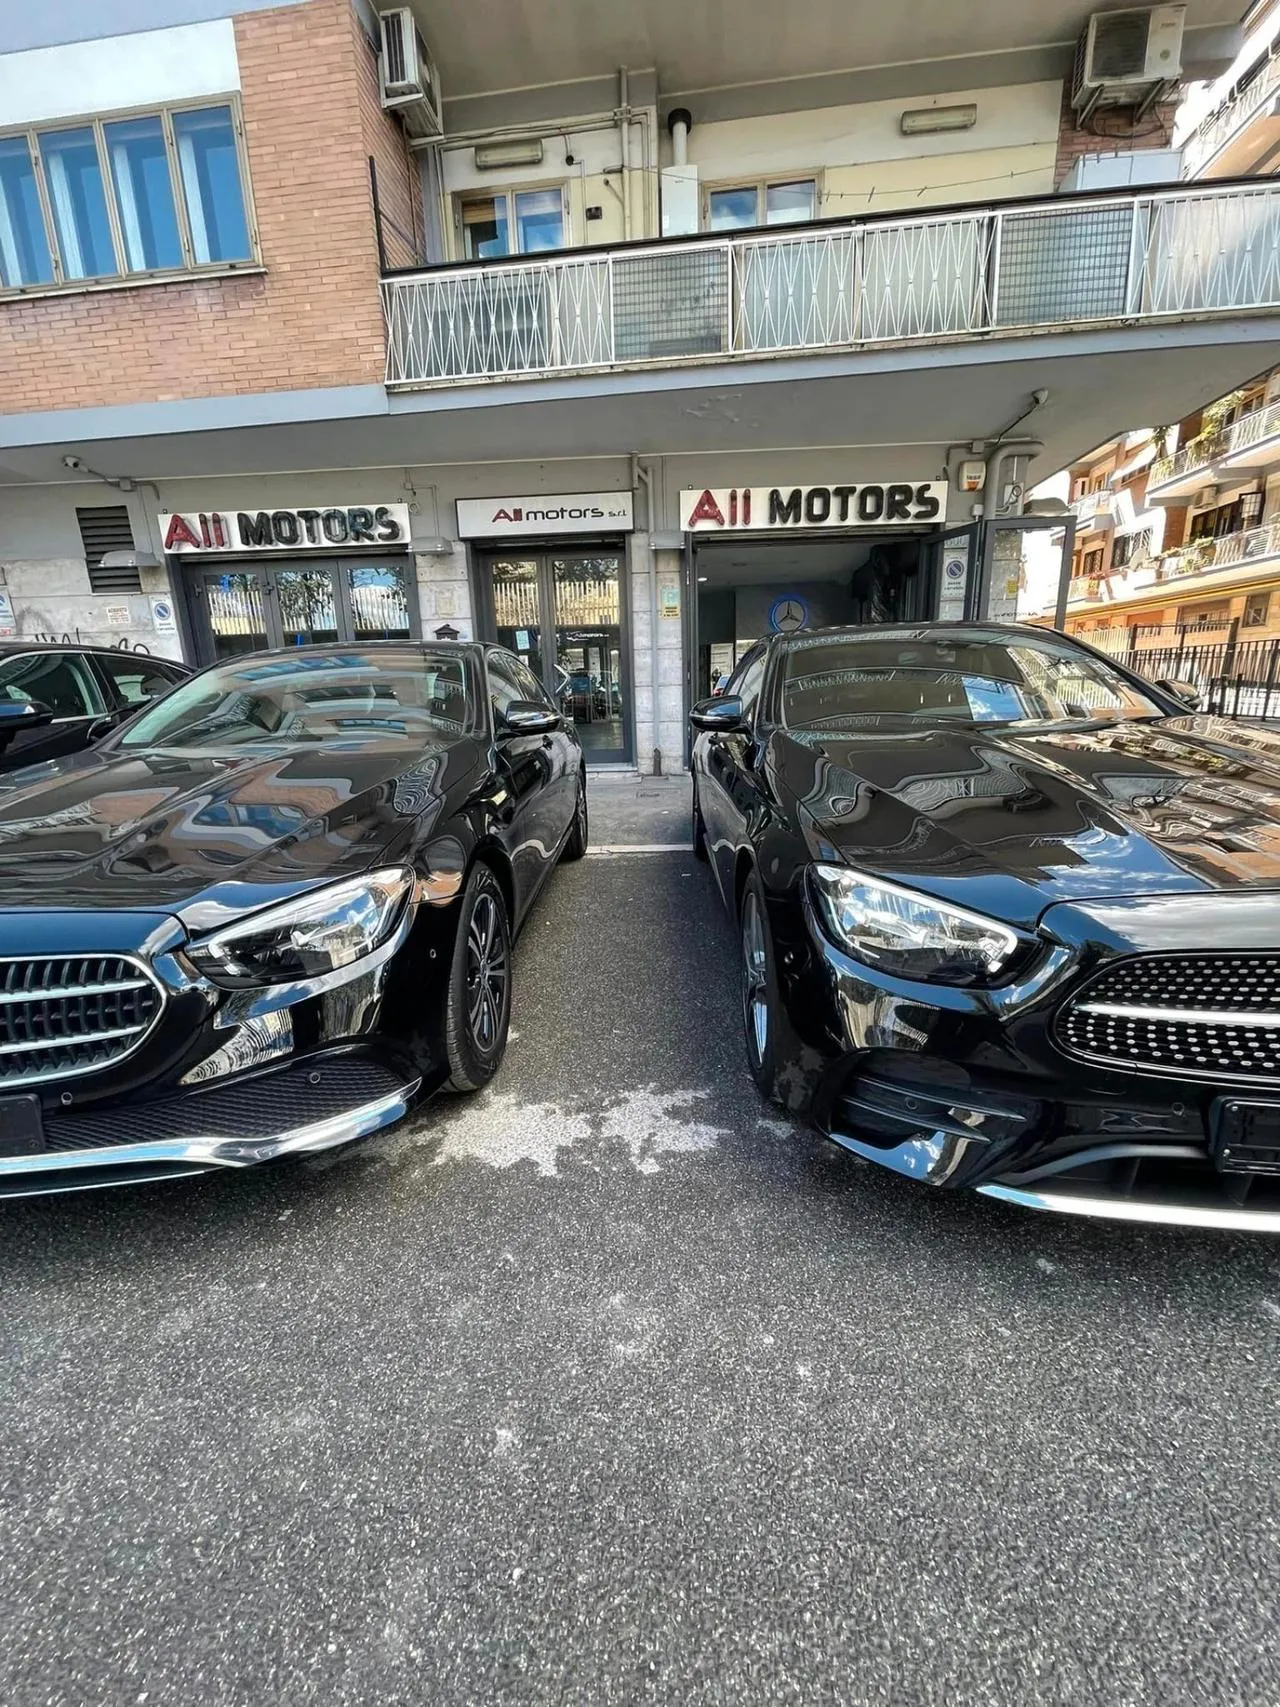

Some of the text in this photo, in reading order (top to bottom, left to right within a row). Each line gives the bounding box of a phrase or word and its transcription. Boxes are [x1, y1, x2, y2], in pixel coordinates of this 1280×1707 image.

[491, 508, 522, 522] All
[526, 507, 604, 520] motors
[688, 484, 940, 527] All MOTORS
[165, 507, 399, 549] All MOTORS
